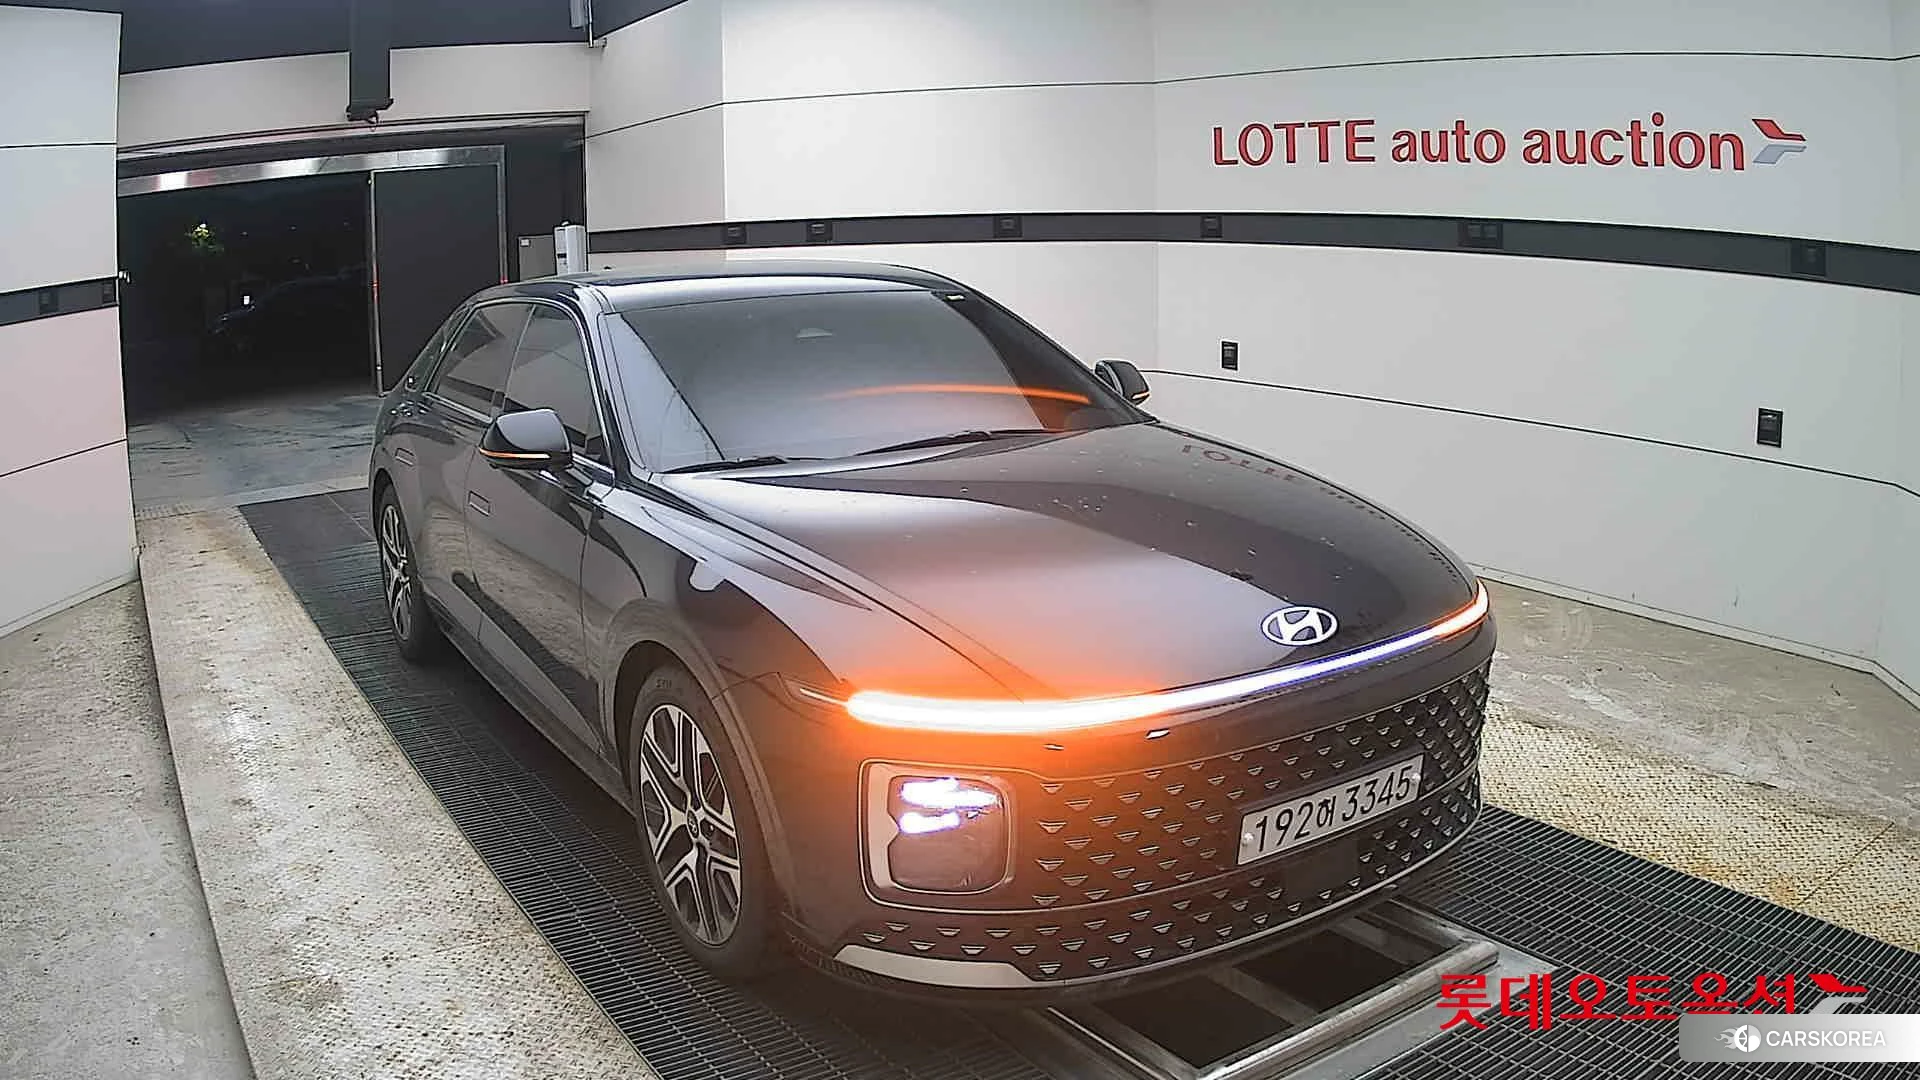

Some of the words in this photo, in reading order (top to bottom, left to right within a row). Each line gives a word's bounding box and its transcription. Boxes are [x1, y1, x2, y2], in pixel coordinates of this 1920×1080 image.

[1212, 119, 1377, 166] LOTTE
[1391, 119, 1507, 164] auto
[1522, 112, 1745, 171] auction
[1341, 765, 1413, 823] 3345
